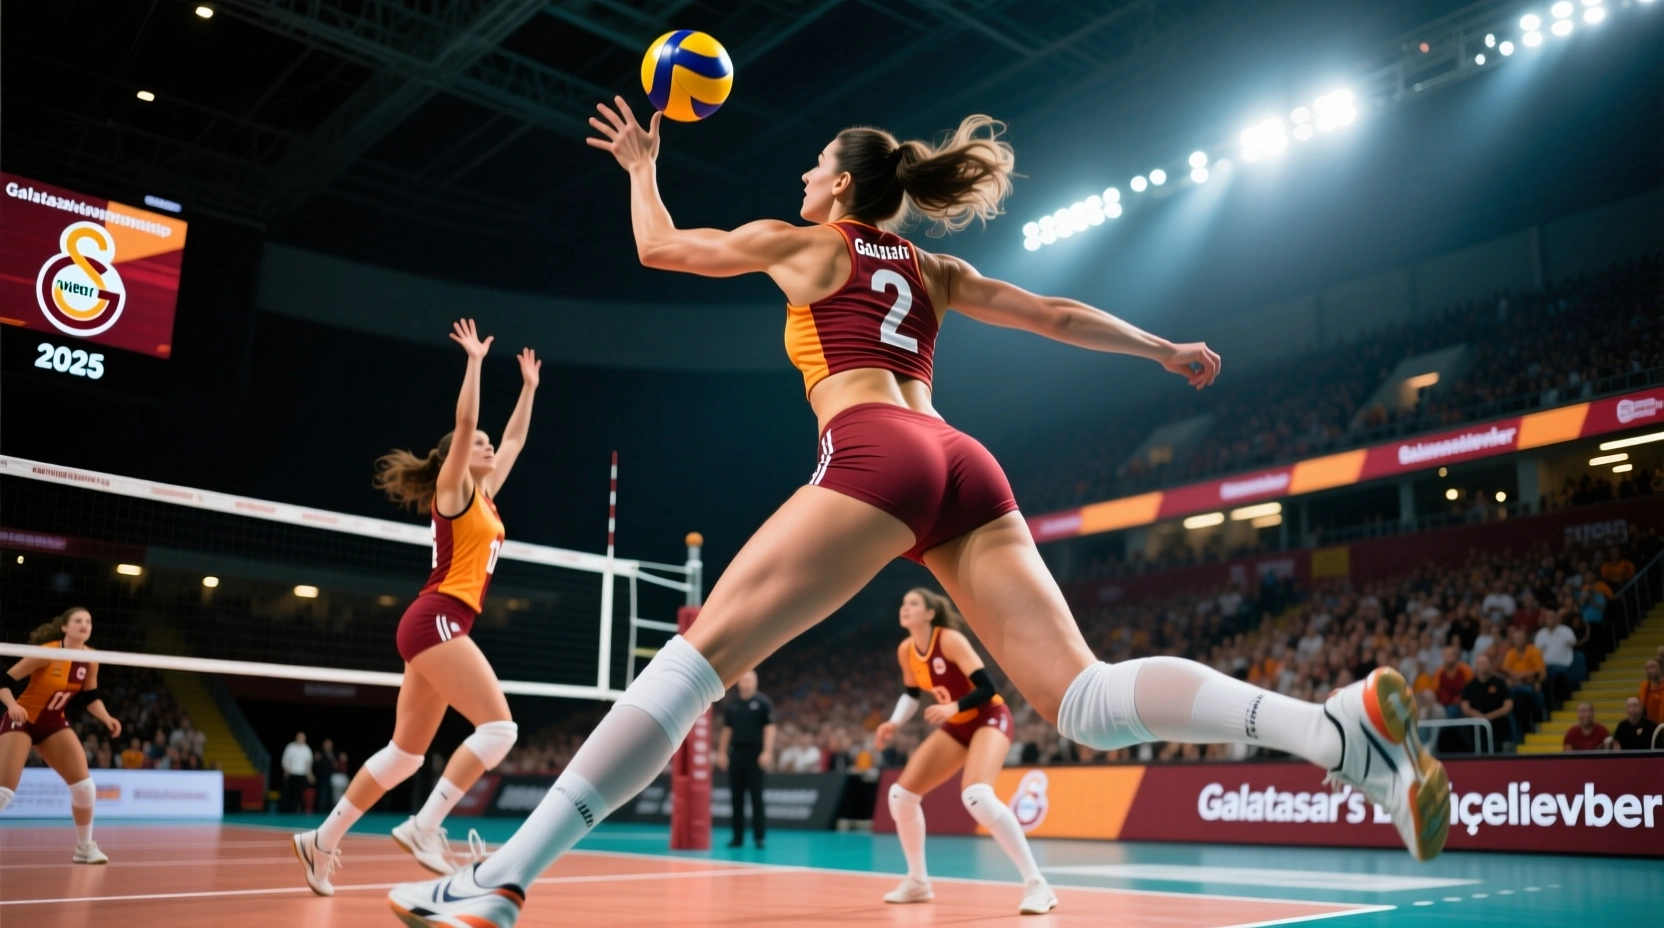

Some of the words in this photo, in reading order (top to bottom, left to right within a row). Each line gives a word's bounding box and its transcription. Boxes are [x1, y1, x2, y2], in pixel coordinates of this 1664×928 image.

[871, 268, 919, 354] 2
[34, 342, 105, 380] 2025
[1198, 783, 1366, 824] Galatasar's
